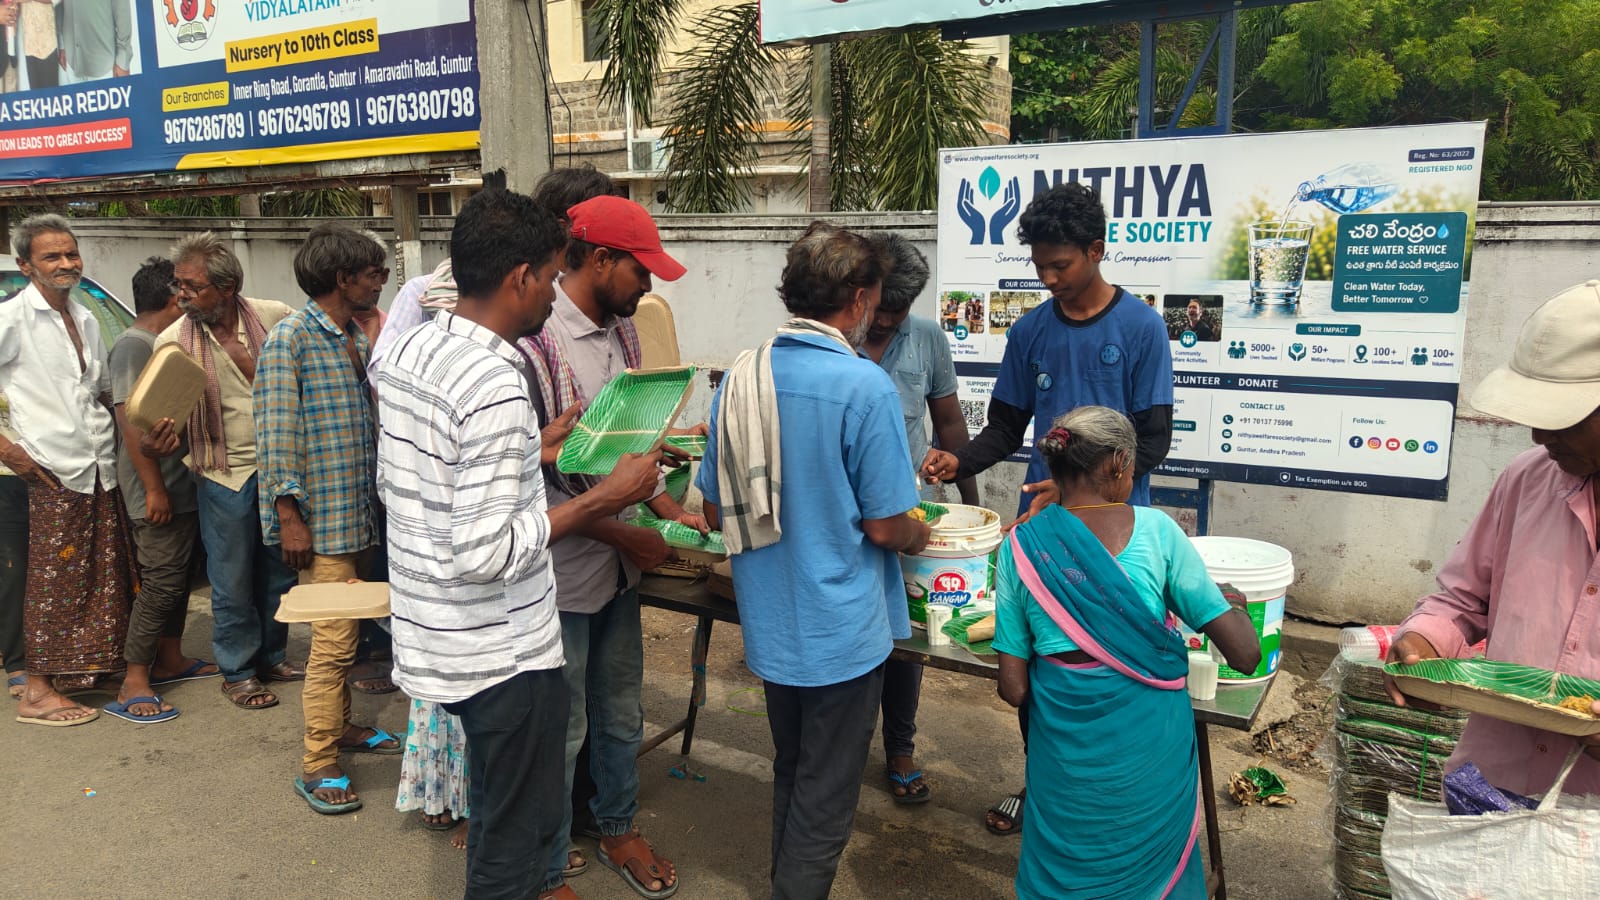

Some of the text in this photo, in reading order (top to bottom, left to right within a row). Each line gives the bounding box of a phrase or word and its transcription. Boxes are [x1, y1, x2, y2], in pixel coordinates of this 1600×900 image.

[230, 28, 375, 63] Nursery to 10th Class
[364, 54, 473, 84] Amaravathi Road, Guntur
[233, 69, 356, 101] Inner Ring Road, Gorantla, Guntur
[12, 95, 74, 121] SEKHAR
[76, 85, 131, 114] REDDY
[166, 88, 225, 105] Our Branches
[366, 86, 475, 126] 9676380798
[258, 100, 351, 137] 9676296789
[164, 111, 245, 145] 9676286789
[17, 135, 42, 150] LEADS
[43, 134, 55, 148] TO
[56, 132, 83, 147] GREAT
[1408, 165, 1455, 173] REGISTERED
[1033, 163, 1212, 218] THYA
[1126, 221, 1212, 243] SOCIETY
[1348, 219, 1437, 243] చలి వేంద్రం
[1346, 244, 1448, 255] FREE WATER SERVICE
[995, 252, 1032, 267] Serving
[1114, 251, 1173, 267] Compassion
[1343, 282, 1425, 292] Clean Water Today,
[1343, 294, 1414, 304] Better Tomorrow
[1250, 344, 1276, 352] 5000+
[1312, 345, 1328, 353] 50+
[1373, 347, 1396, 356] 100+
[1432, 349, 1454, 358] 100+
[1173, 375, 1220, 385] LUNTEER
[1238, 378, 1279, 388] DONATE
[1240, 402, 1273, 410] CONTACT
[1281, 449, 1306, 457] Pradesh
[1306, 476, 1340, 485] Exemption
[932, 594, 968, 604] SANGAM
